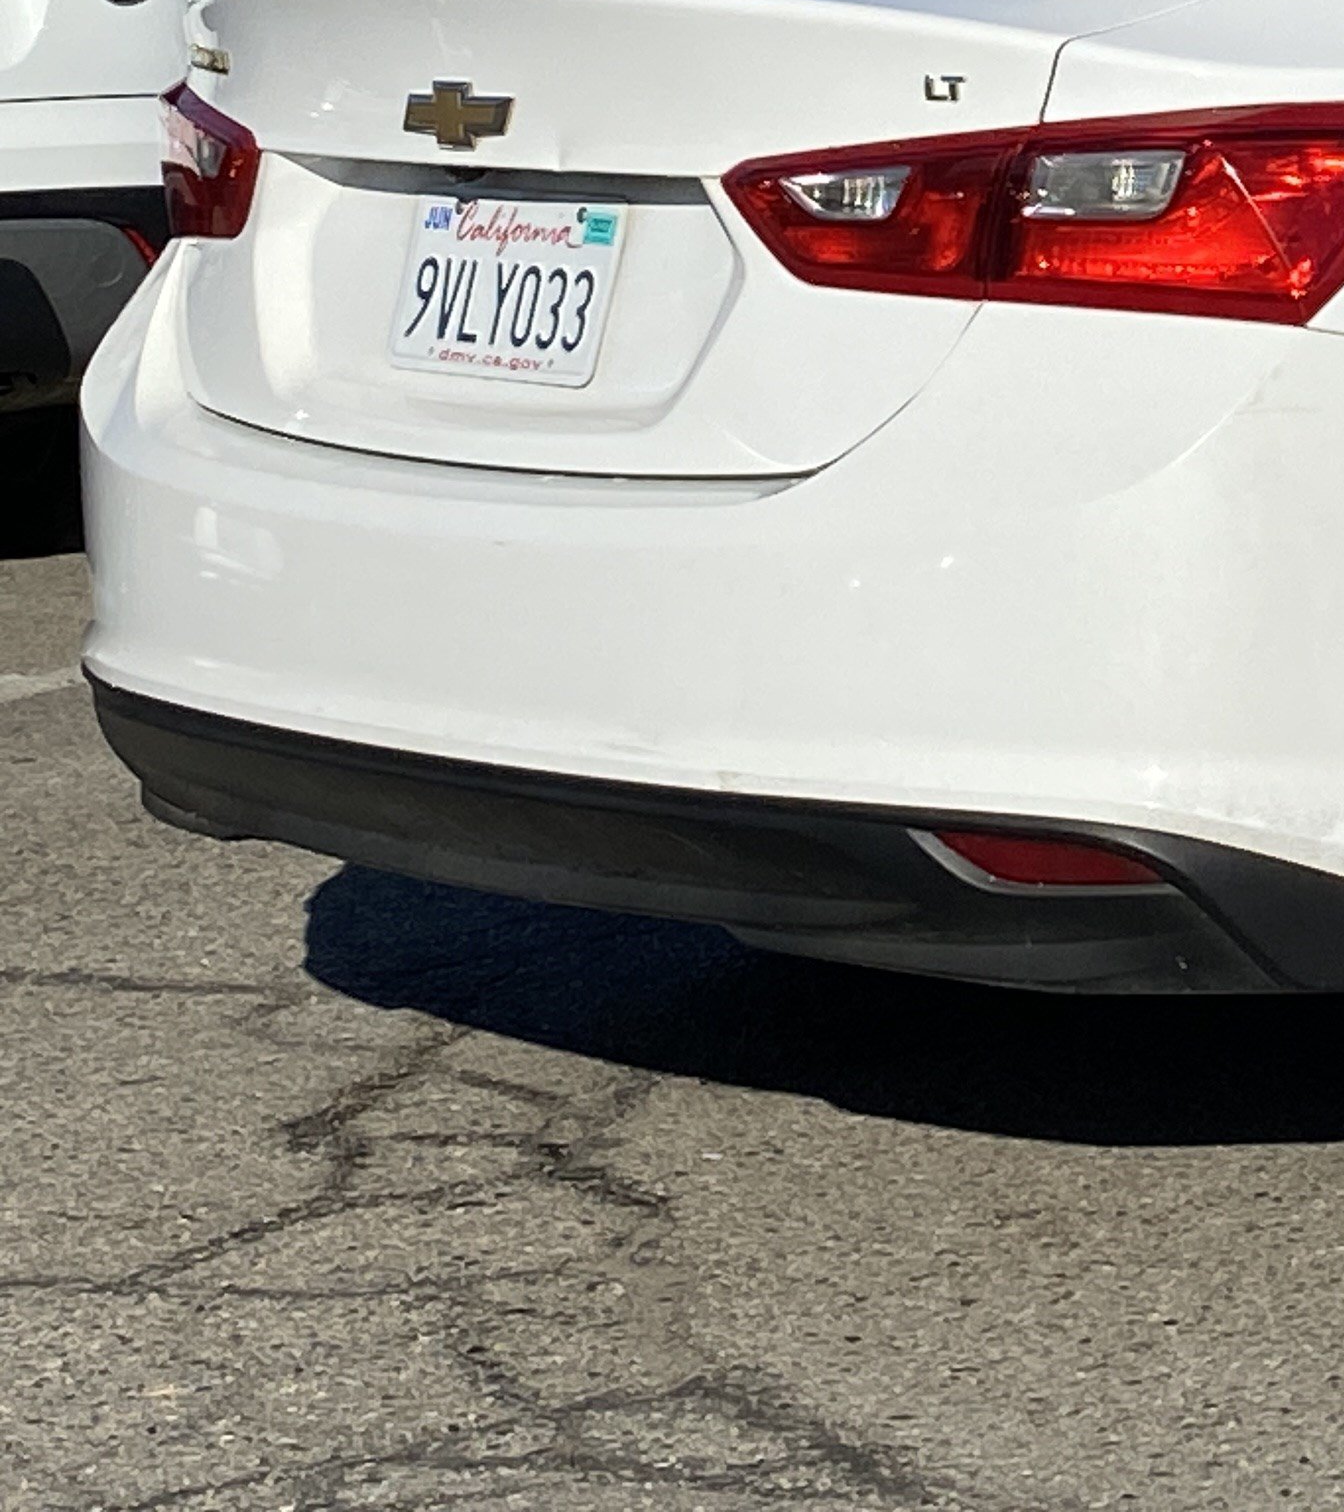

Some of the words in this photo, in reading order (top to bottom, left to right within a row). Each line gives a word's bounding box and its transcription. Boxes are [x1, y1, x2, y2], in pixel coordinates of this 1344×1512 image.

[924, 74, 967, 102] LT
[456, 199, 583, 256] California
[404, 256, 595, 353] 9VLY033
